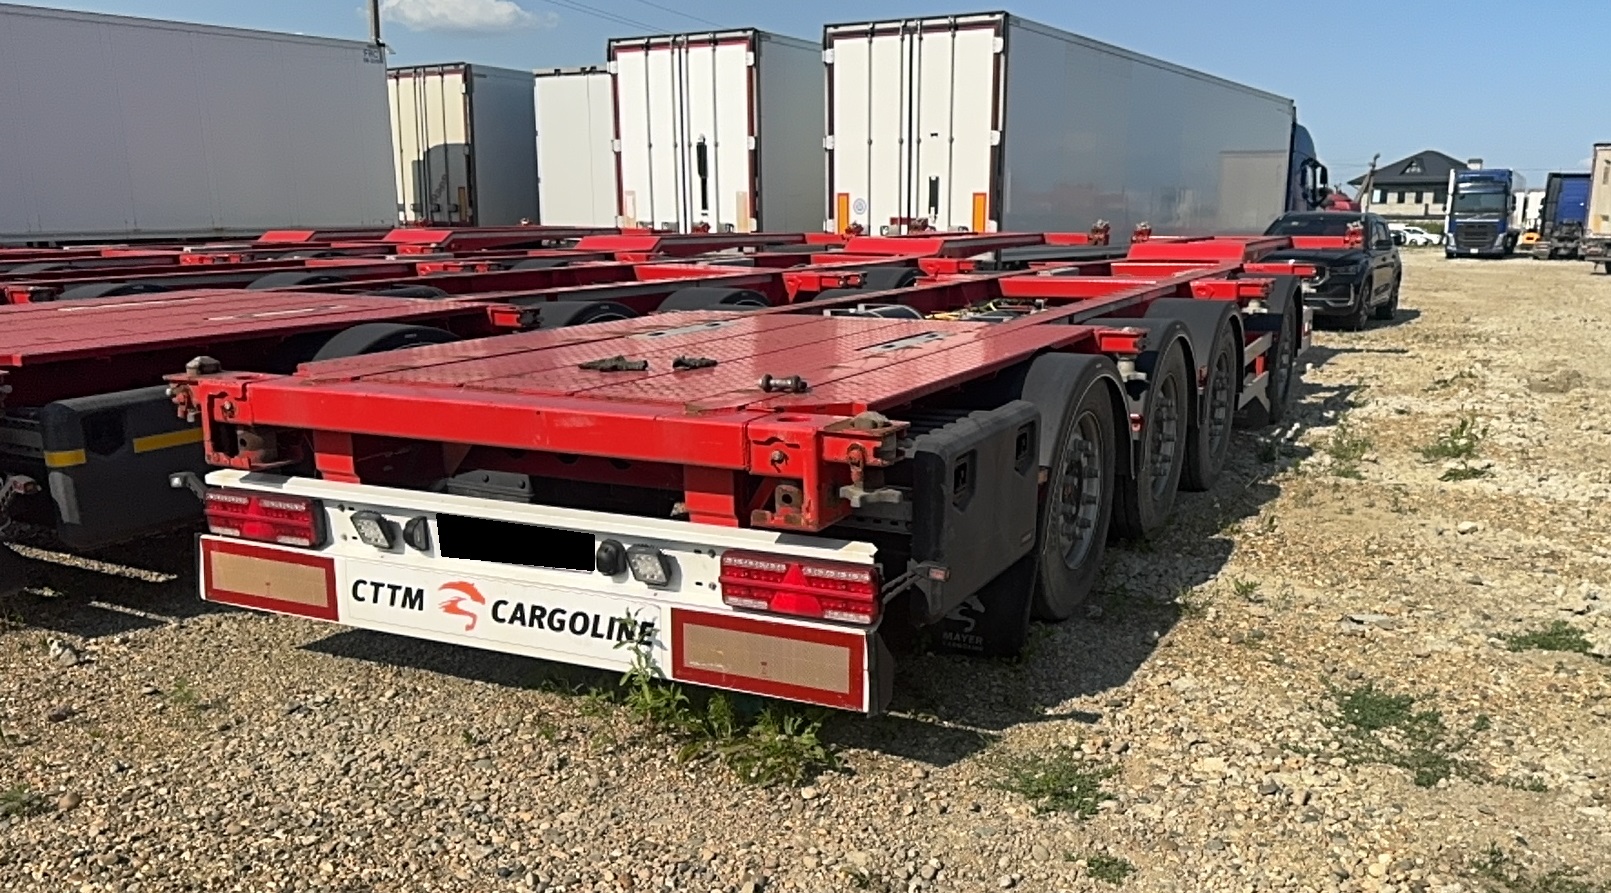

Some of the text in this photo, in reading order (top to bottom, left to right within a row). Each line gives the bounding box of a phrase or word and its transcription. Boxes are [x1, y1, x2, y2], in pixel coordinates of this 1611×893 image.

[351, 579, 655, 646] CTTM CARGOLINE
[942, 632, 984, 645] MAYER
